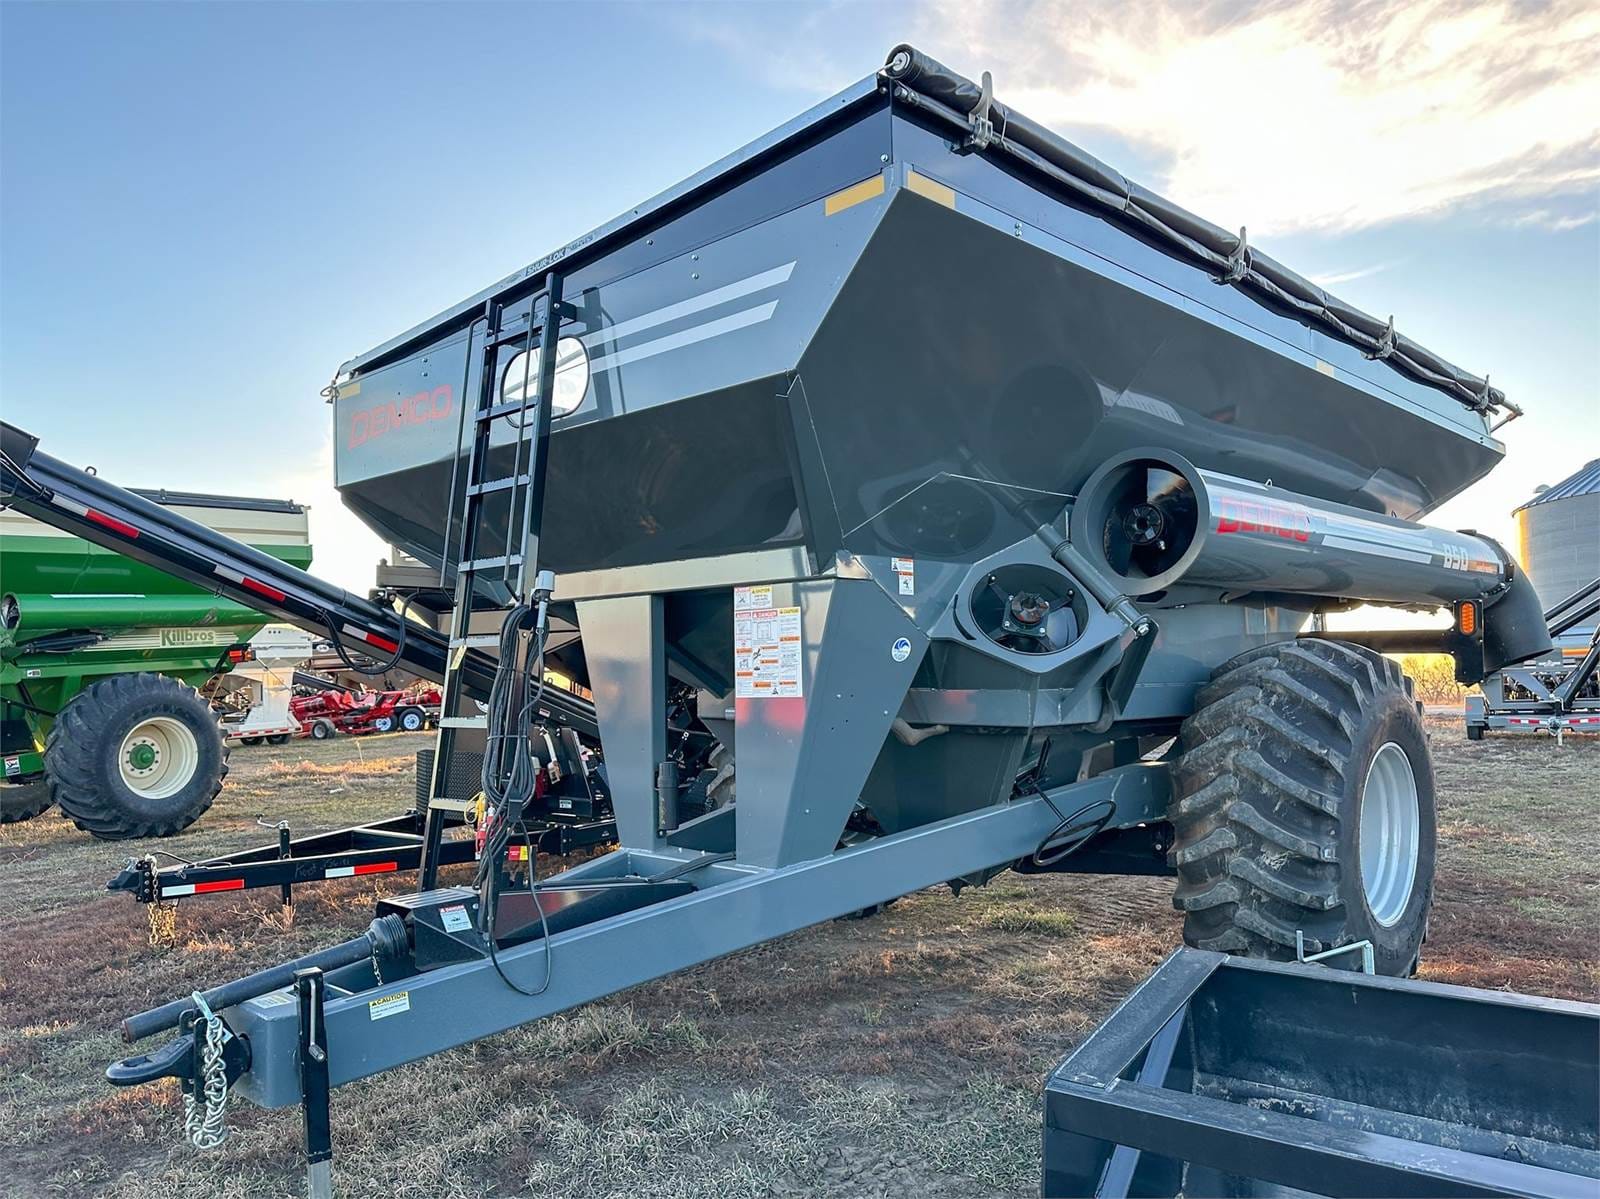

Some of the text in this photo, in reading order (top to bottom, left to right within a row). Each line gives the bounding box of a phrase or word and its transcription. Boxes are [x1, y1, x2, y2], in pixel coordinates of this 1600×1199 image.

[348, 384, 452, 451] DEMCO
[1216, 497, 1309, 542] DEMCO
[160, 628, 214, 646] Killbros
[376, 992, 407, 1005] CAUTION
